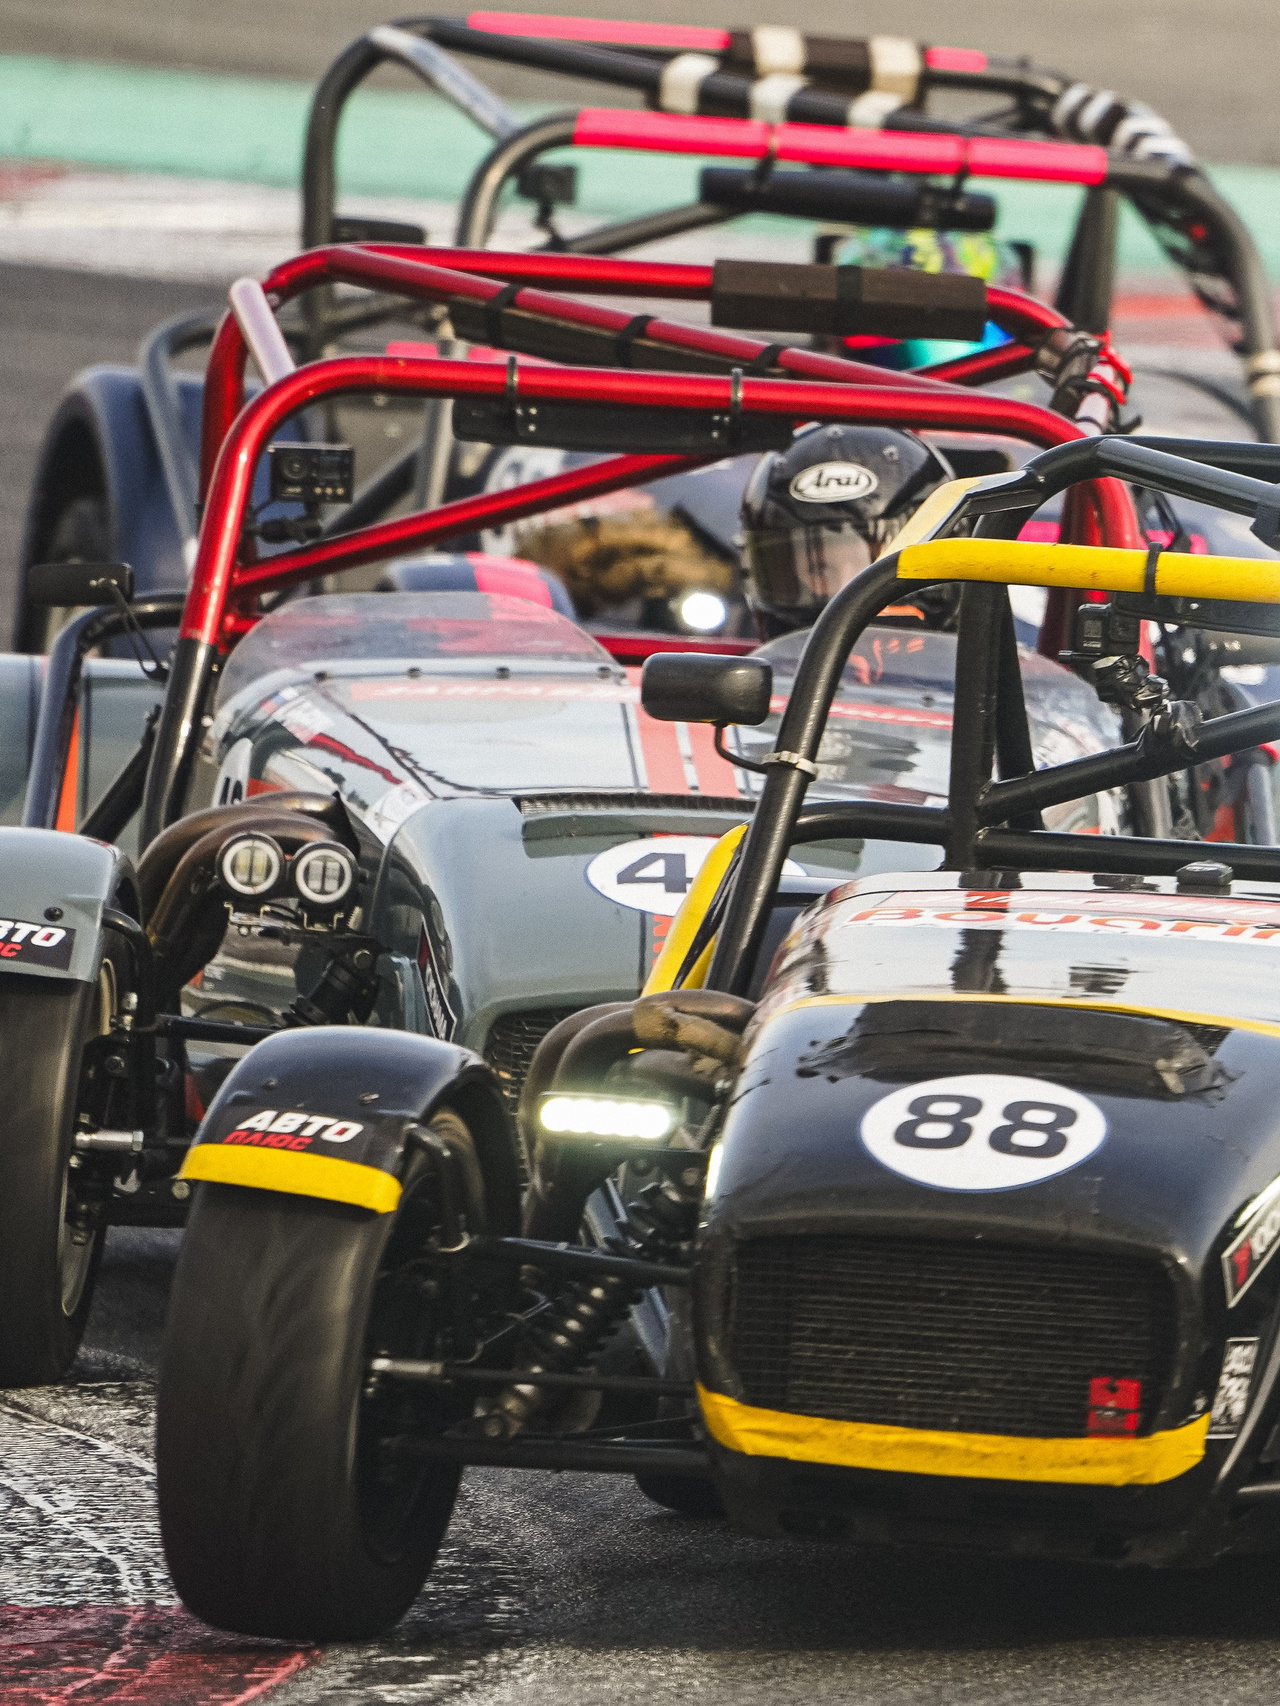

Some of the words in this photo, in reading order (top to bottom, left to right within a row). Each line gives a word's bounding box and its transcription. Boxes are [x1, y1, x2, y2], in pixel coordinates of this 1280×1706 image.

[794, 467, 871, 495] Arai
[222, 1129, 313, 1151] ПЛЮС
[235, 1109, 364, 1144] АВТО
[893, 1094, 1078, 1159] 88
